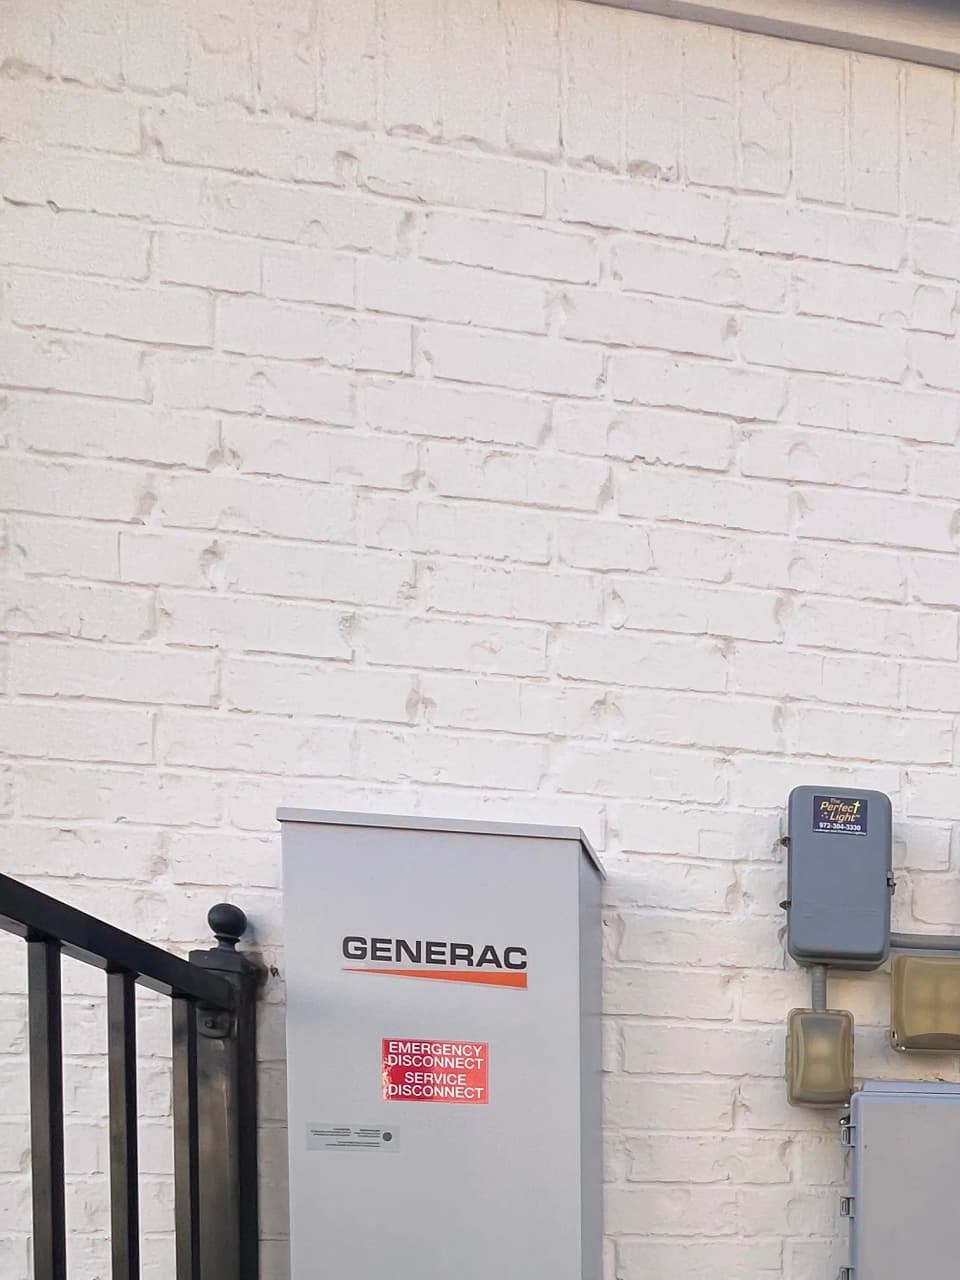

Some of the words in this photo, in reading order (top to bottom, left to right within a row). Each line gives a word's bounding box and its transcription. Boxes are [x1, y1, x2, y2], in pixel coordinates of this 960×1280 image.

[820, 801, 861, 814] Perfect
[830, 812, 856, 823] Light
[342, 936, 528, 970] GENERAC
[389, 1041, 482, 1057] EMERGENCY
[388, 1054, 484, 1070] DISCONNECT
[404, 1071, 467, 1086] SERVICE
[388, 1084, 484, 1099] DISCONNECT
